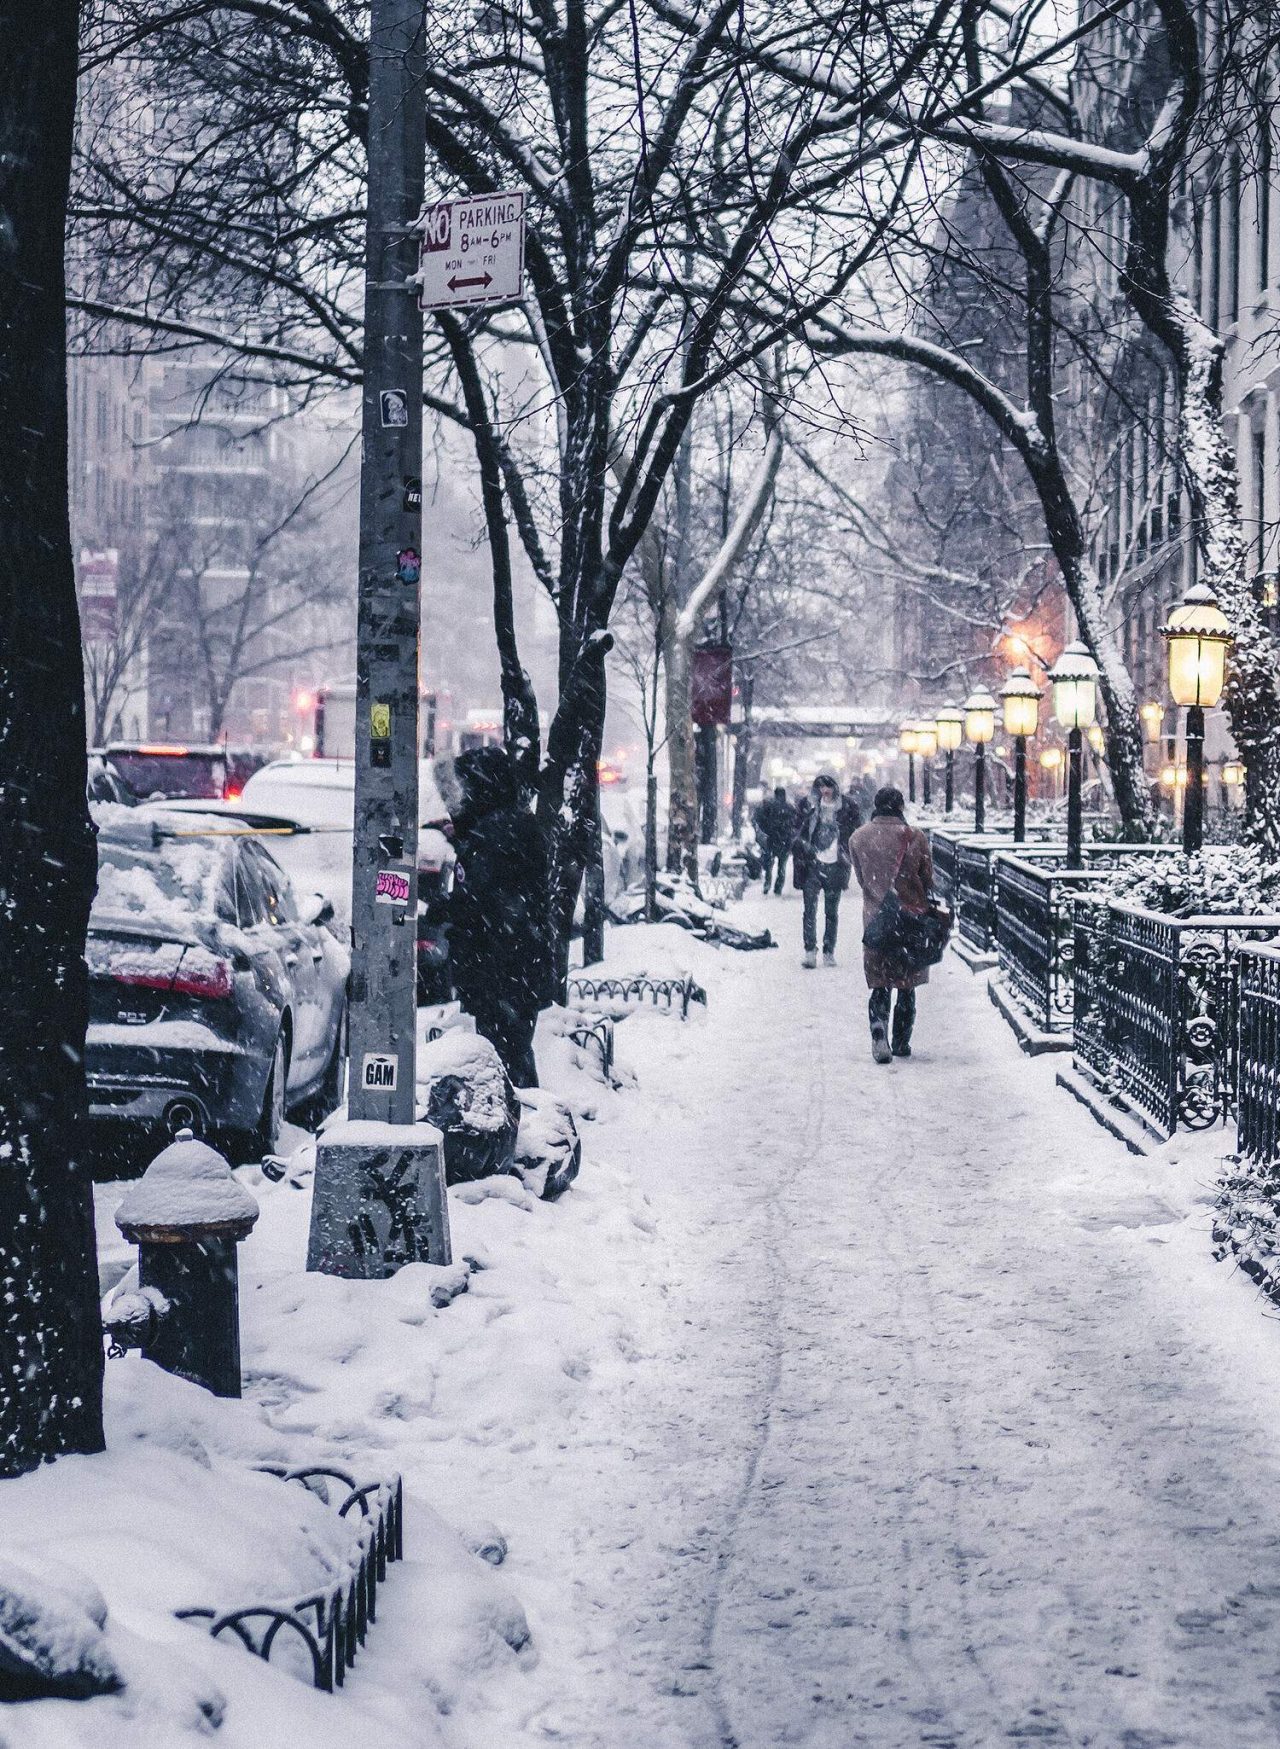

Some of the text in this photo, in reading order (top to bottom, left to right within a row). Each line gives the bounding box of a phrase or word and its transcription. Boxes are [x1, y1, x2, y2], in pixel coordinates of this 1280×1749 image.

[423, 203, 514, 246] NO PARKING
[445, 259, 462, 270] MON
[482, 254, 496, 265] FRI
[366, 1063, 394, 1086] GAM
